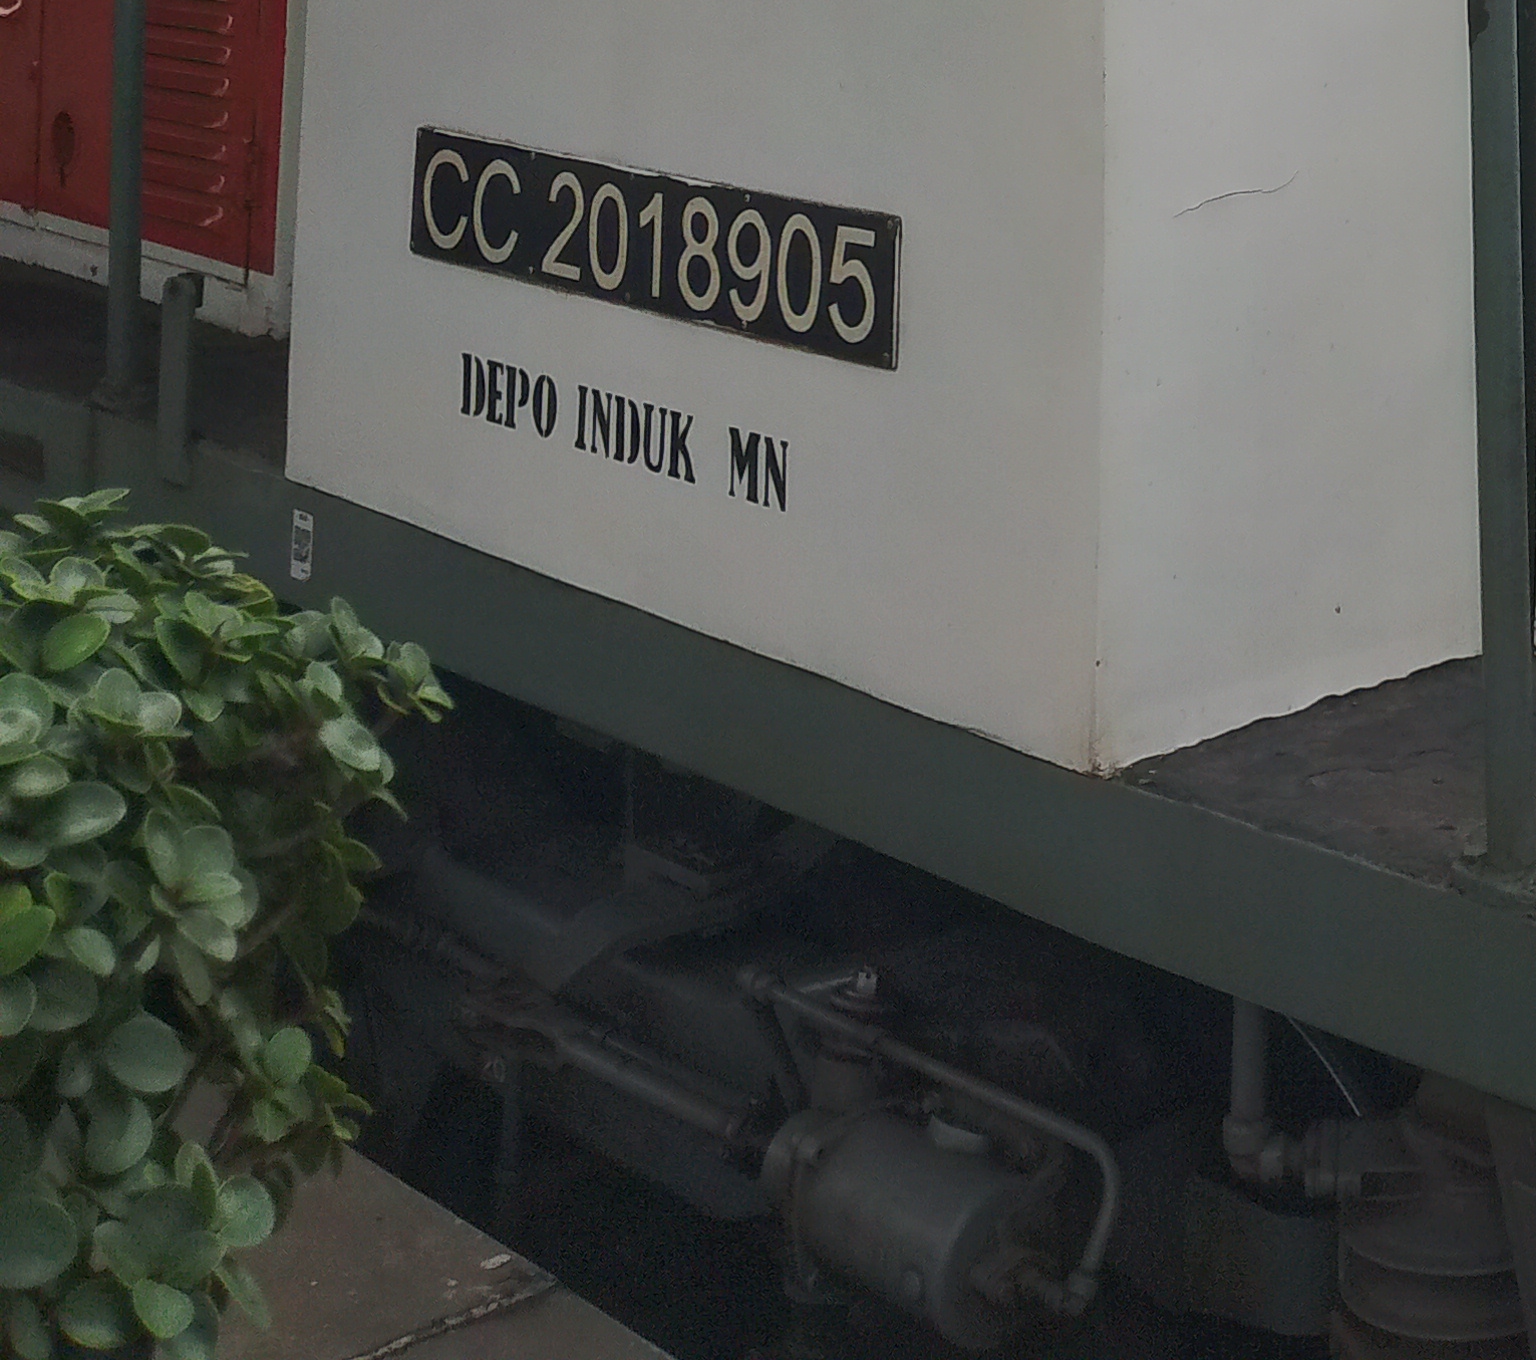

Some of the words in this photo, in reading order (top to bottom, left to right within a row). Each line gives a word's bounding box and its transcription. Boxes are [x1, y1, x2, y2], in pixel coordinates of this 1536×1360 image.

[422, 148, 521, 265] CC
[540, 171, 877, 344] 2018905
[460, 352, 558, 439] DEPO
[574, 384, 696, 484] INDUK
[727, 426, 790, 512] MN
